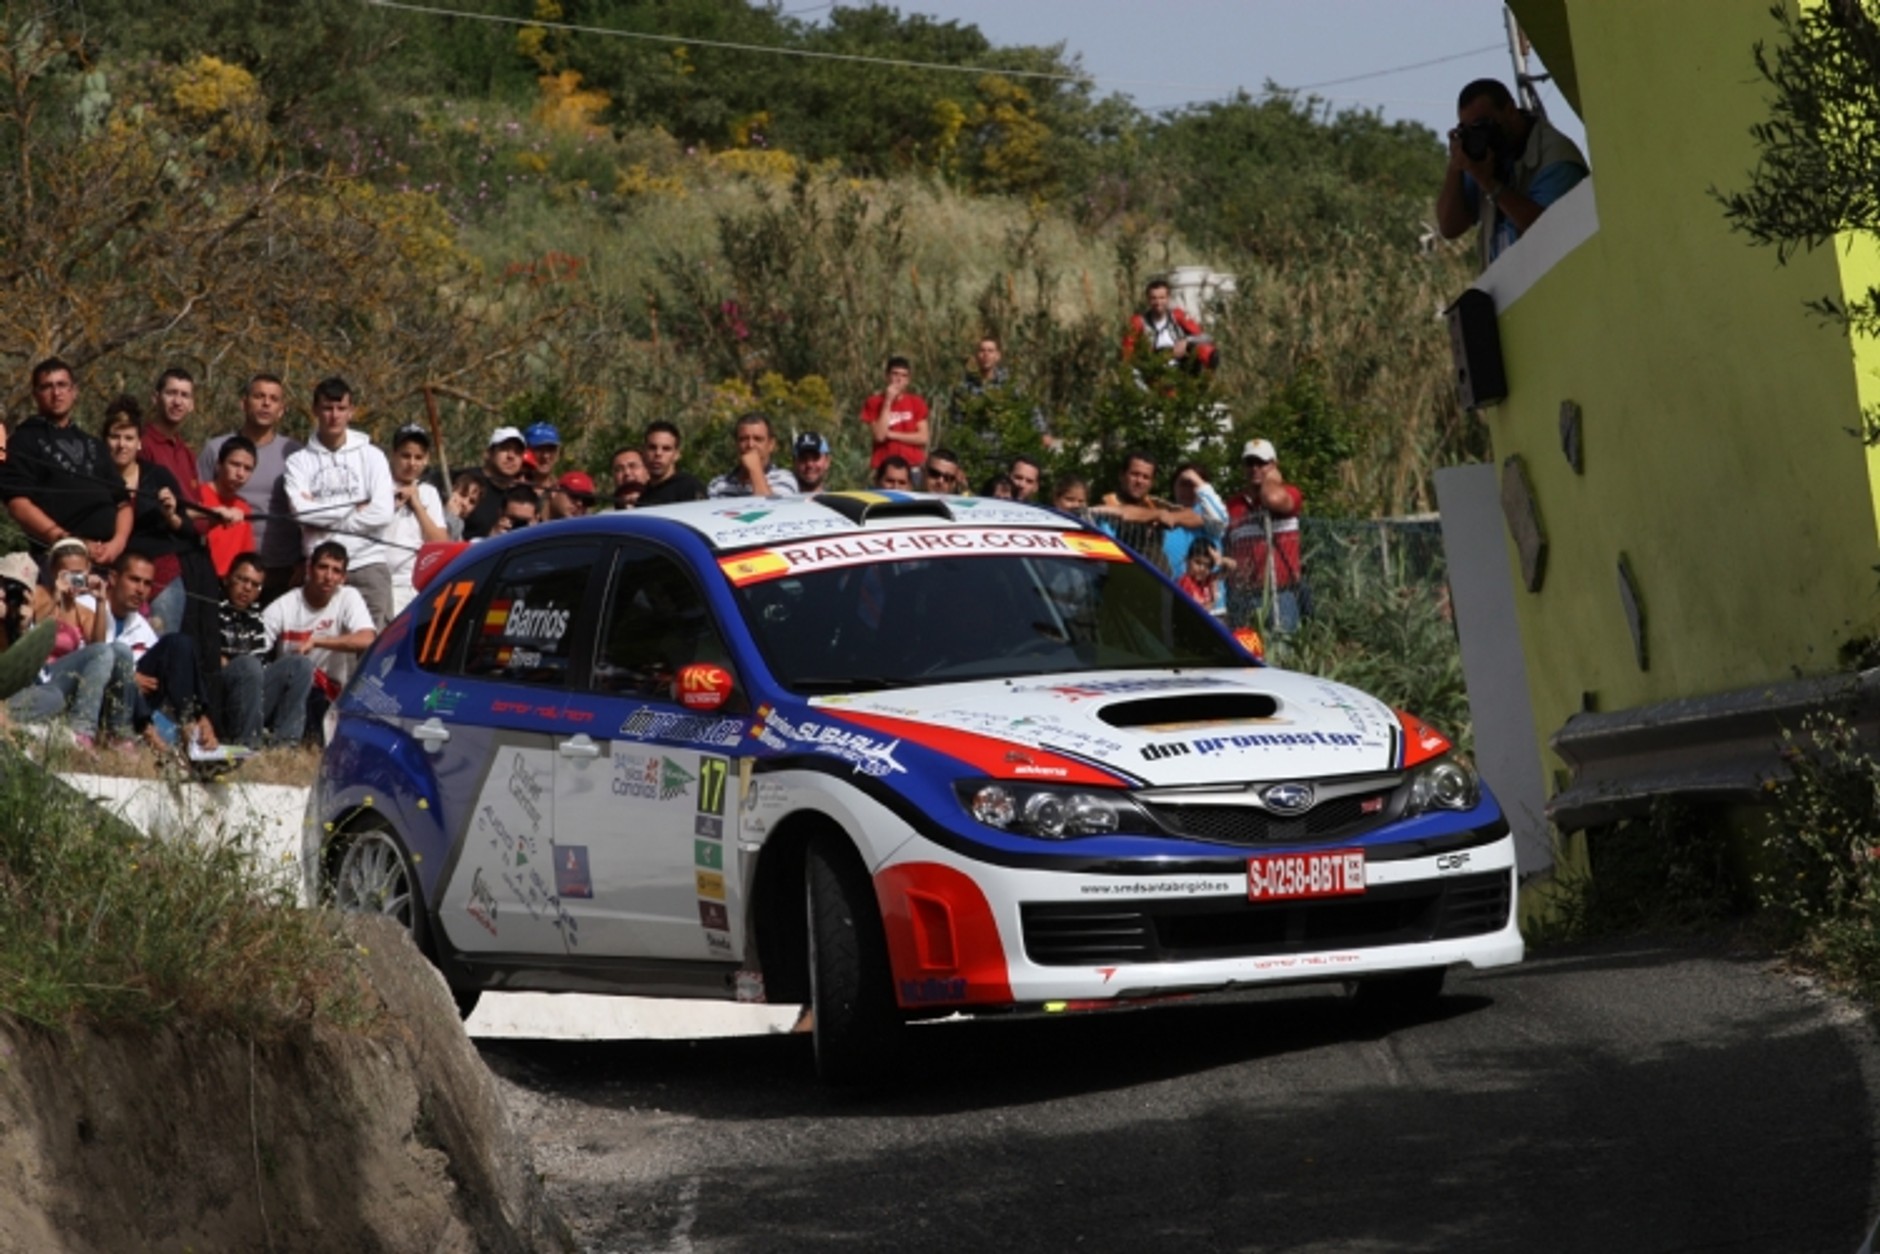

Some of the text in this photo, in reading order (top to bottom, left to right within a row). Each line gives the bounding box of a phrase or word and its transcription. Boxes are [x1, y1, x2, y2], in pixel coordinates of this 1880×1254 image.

[782, 531, 1068, 566] RALLY-IRC.COM
[418, 581, 475, 664] 17
[505, 599, 570, 639] Barrios
[683, 667, 723, 691] IRC
[1140, 730, 1362, 762] dm promaster
[702, 758, 727, 812] 17
[1250, 855, 1342, 897] S-0258-BBT
